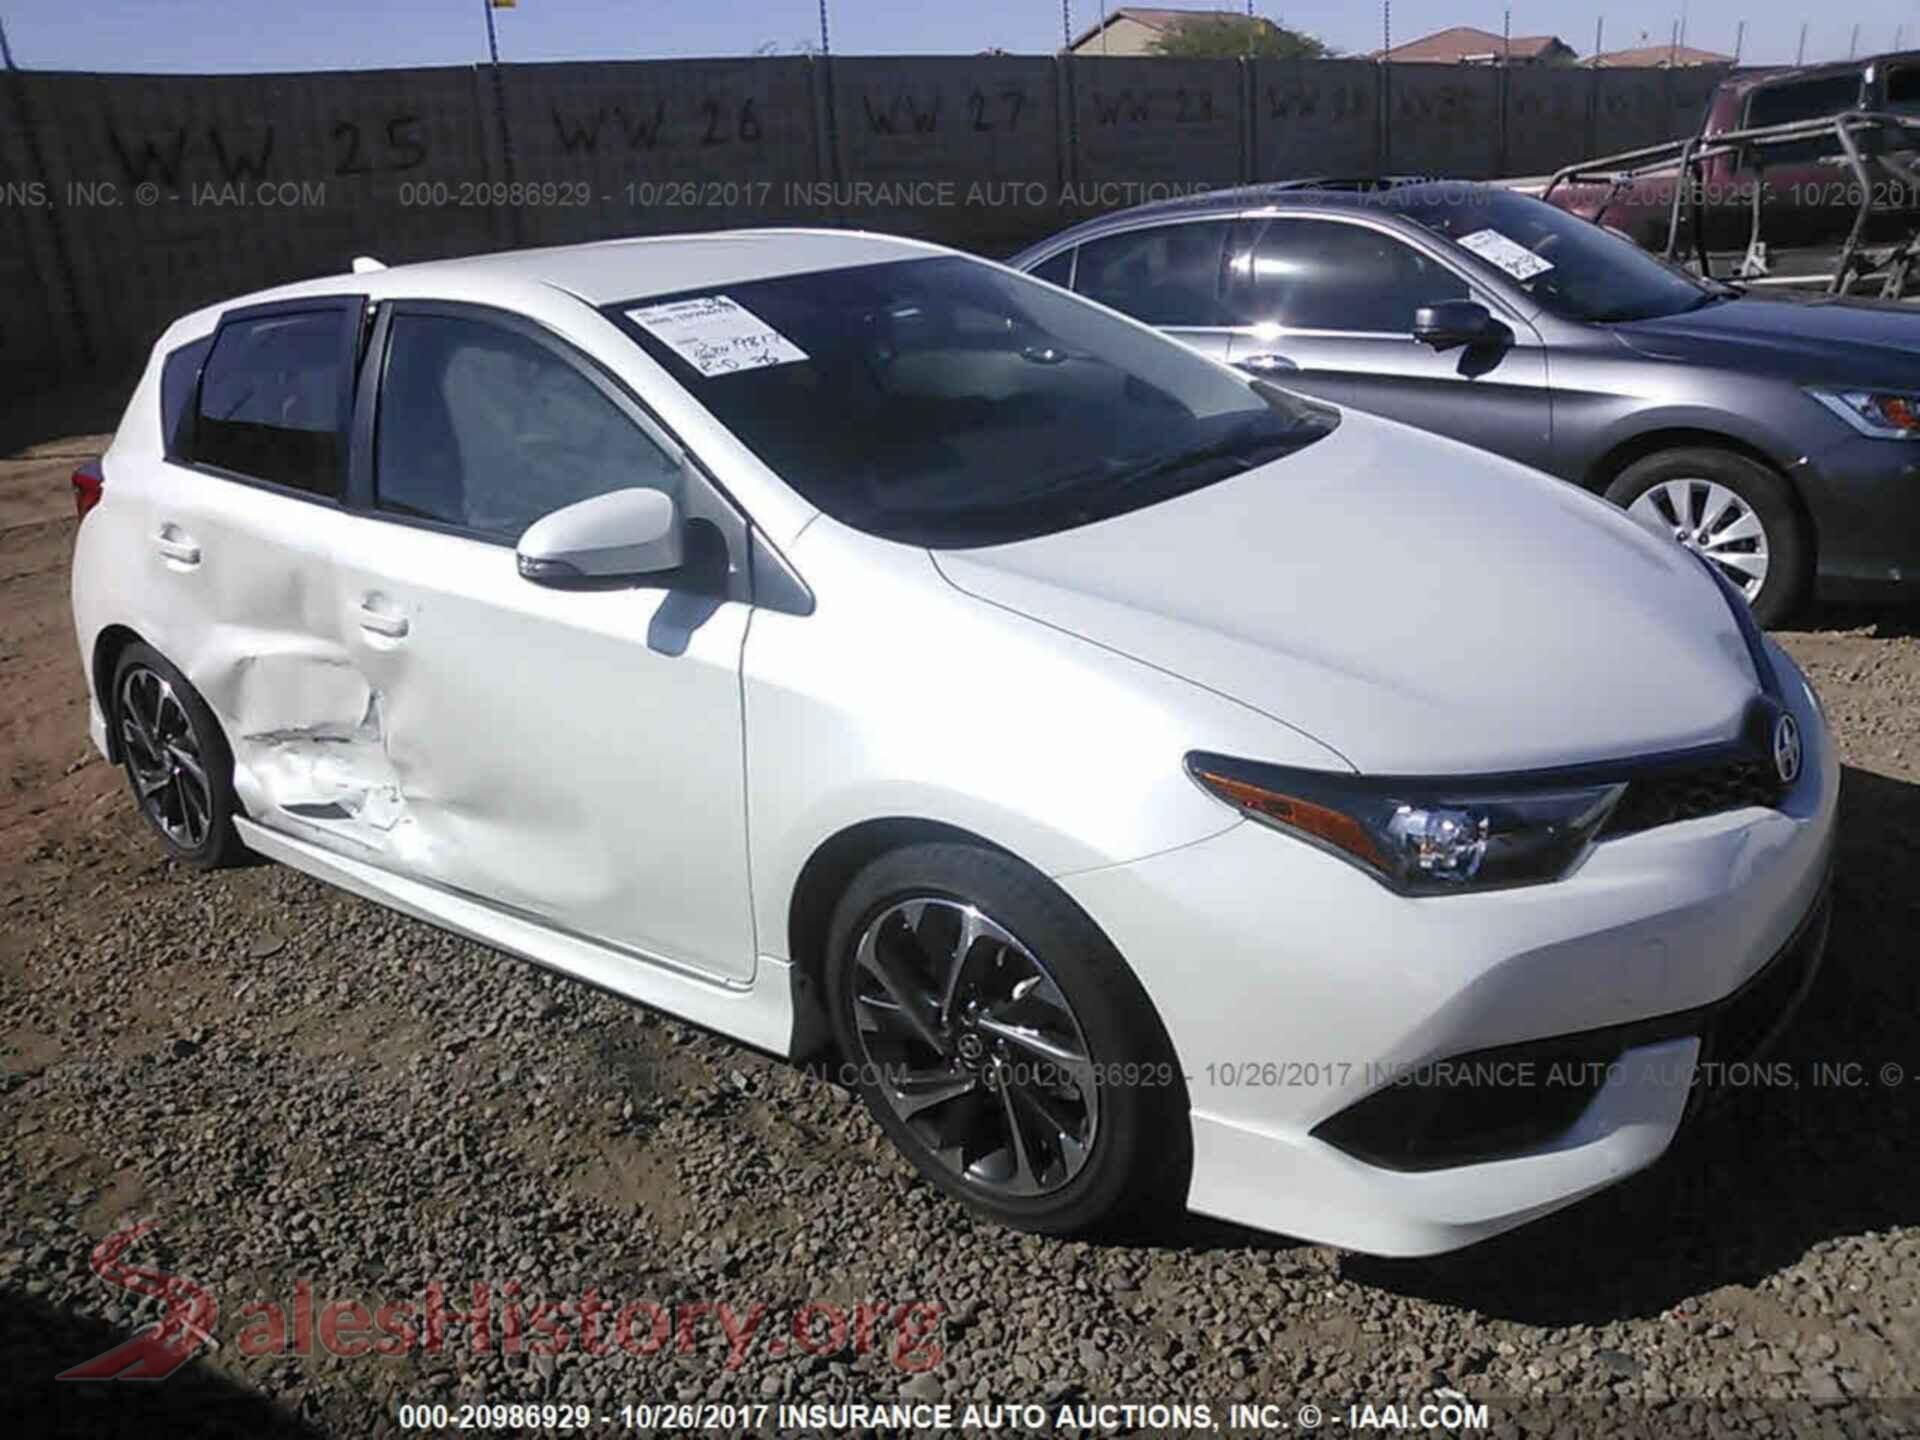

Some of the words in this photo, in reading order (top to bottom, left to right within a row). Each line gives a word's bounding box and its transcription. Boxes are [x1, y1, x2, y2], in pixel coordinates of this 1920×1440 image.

[699, 98, 764, 145] 26
[970, 90, 1028, 132] 27
[333, 115, 428, 175] 25
